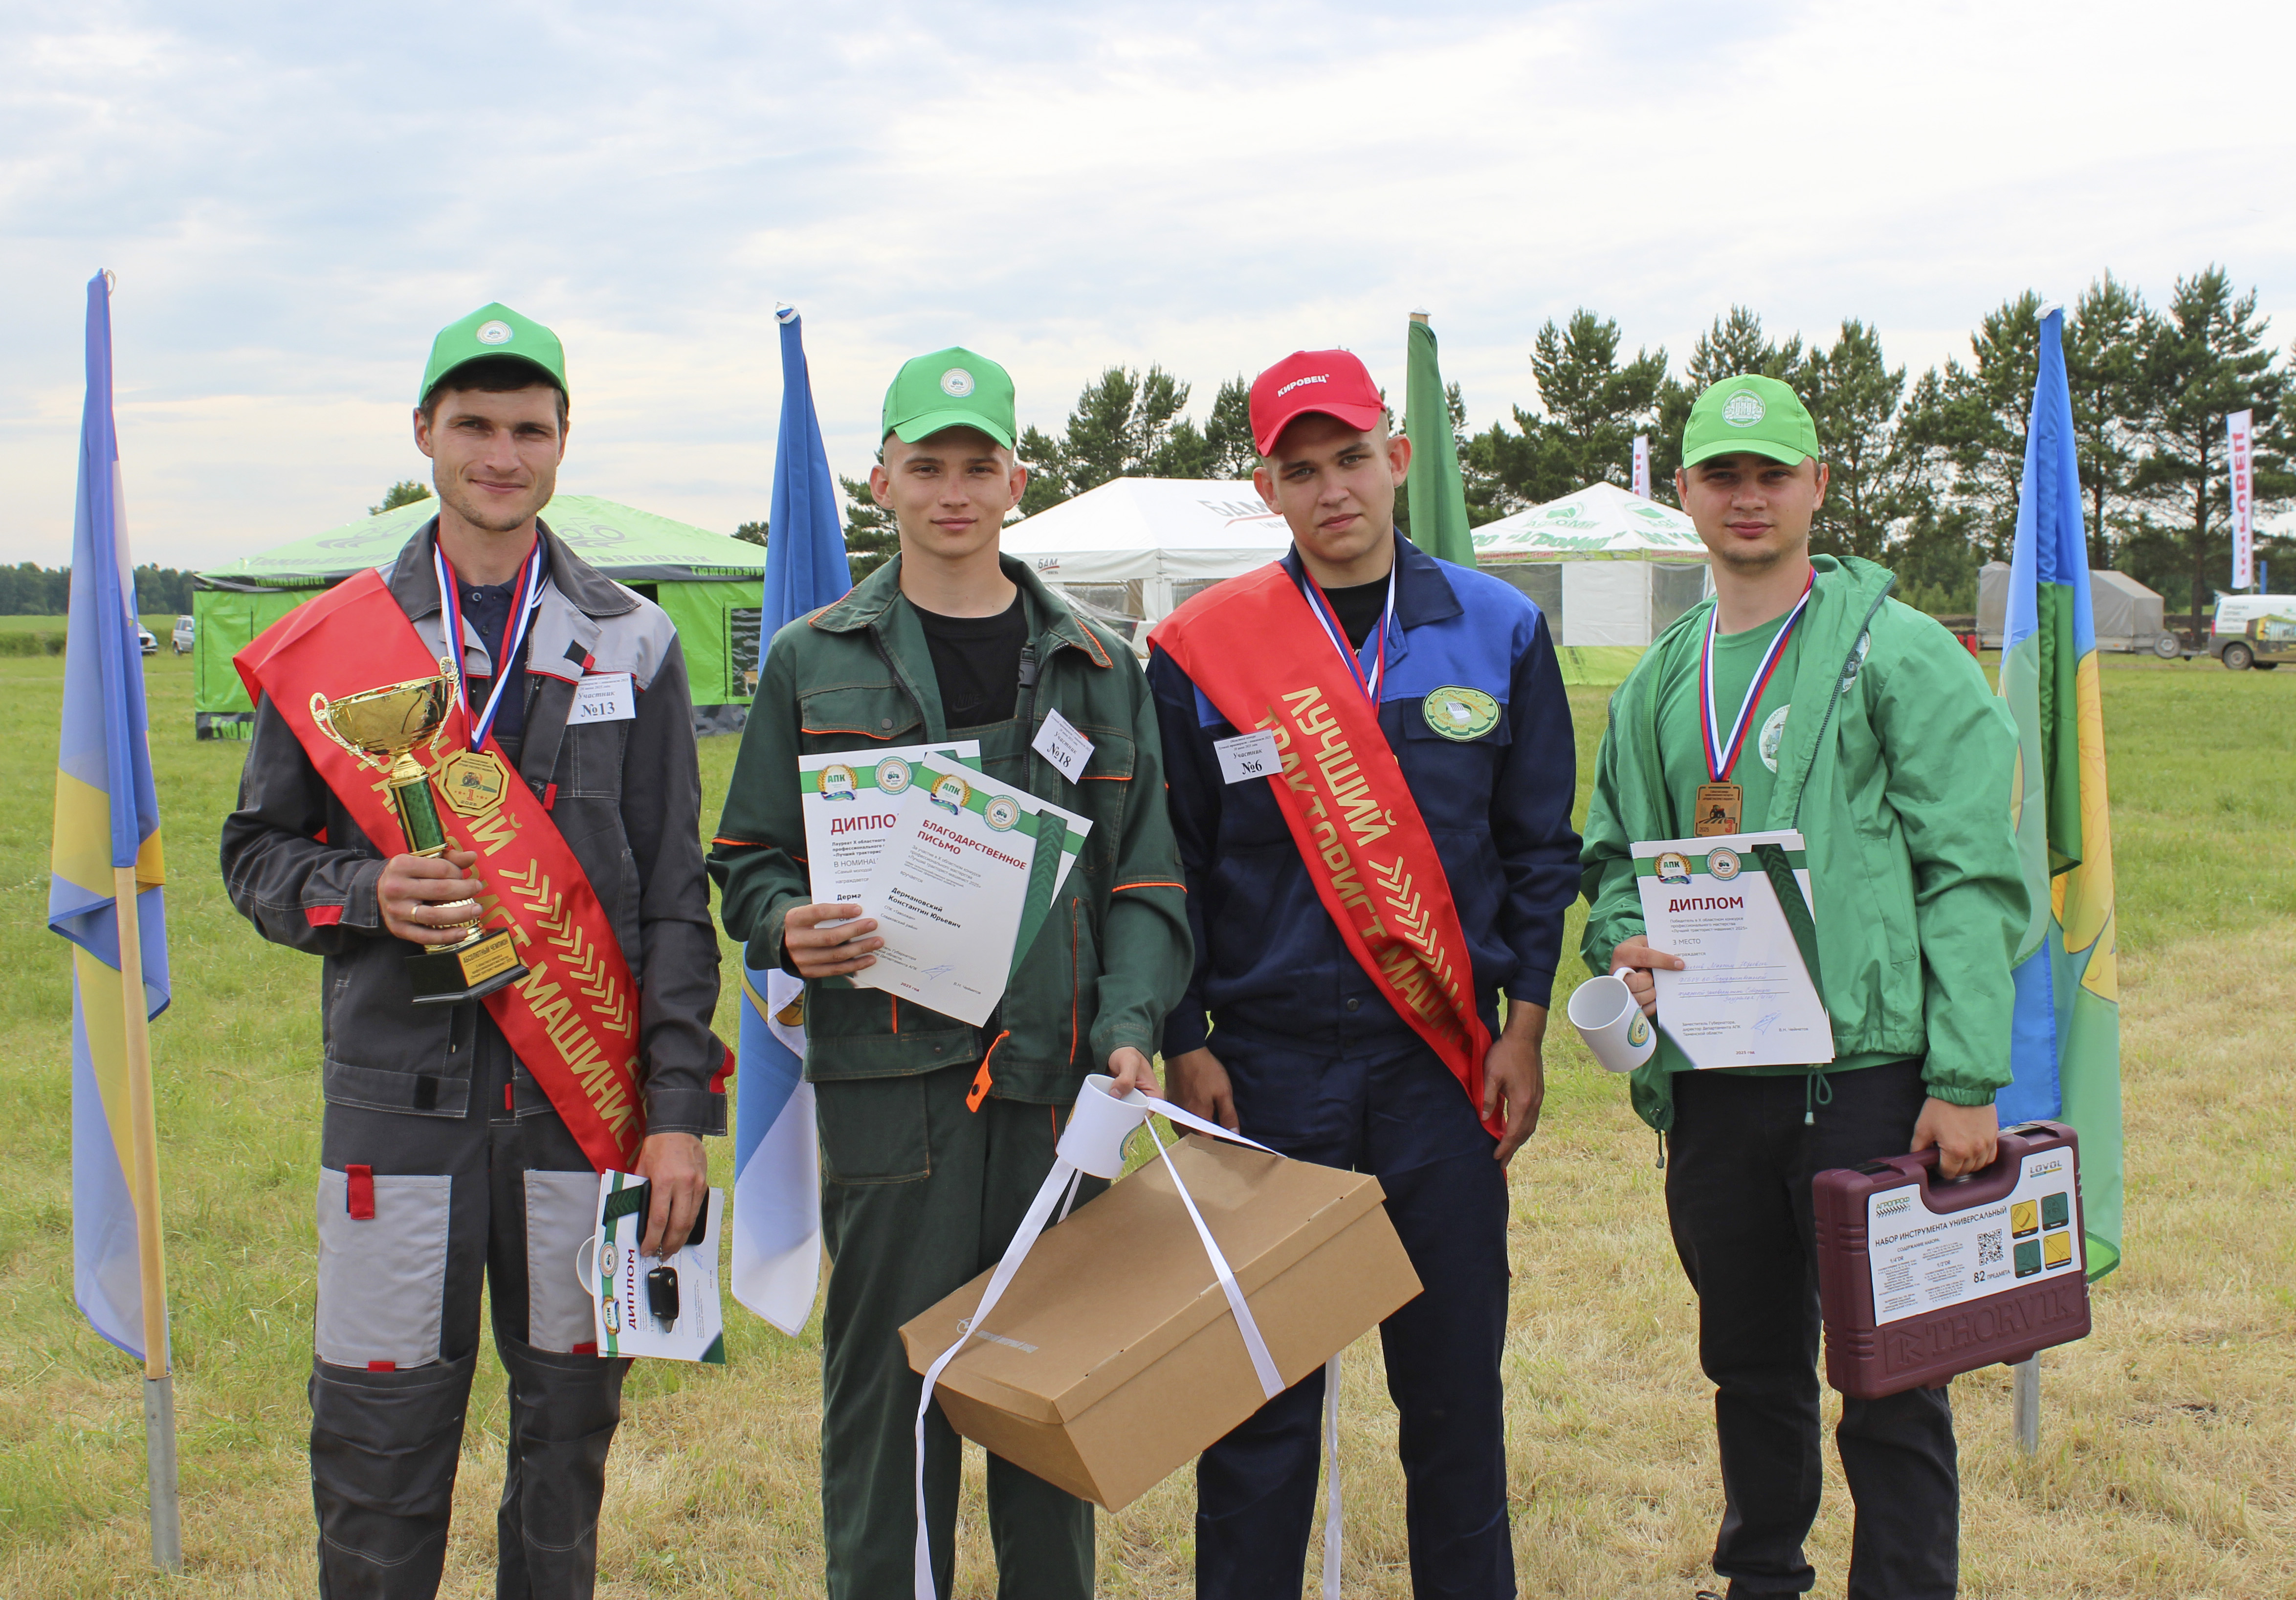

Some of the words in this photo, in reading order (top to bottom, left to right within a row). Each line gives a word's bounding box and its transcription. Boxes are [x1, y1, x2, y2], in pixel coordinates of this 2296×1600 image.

[1277, 375, 1327, 397] КИРОВЕЦ
[690, 566, 766, 576] Тюменьагр
[1038, 558, 1058, 569] БАМ
[581, 702, 615, 717] №13
[1054, 732, 1077, 755] Участник
[1047, 742, 1071, 767] №18
[1233, 749, 1263, 758] Участник
[1241, 759, 1262, 775] №6
[1281, 686, 1397, 847] ЛУЧШИЙ
[827, 773, 845, 783] АПК
[467, 789, 474, 800] 1
[942, 782, 960, 796] АПК
[831, 814, 898, 836] ДИПЛО
[1725, 819, 1733, 833] 3
[917, 831, 961, 855] ПИСЬМО
[923, 820, 1027, 870] БЛАГОДАРСТВЕННОЕ
[891, 887, 943, 912] Дермановский
[1669, 896, 1744, 912] ДИПЛОМ
[888, 895, 929, 916] Константин
[930, 912, 961, 929] Юрьевич
[2030, 1160, 2062, 1174] LOVOL
[1876, 1197, 1910, 1210] АГРОПРОФ
[1875, 1234, 1899, 1247] НАБОР
[1899, 1222, 1948, 1240] ИНСТРУМЕНТА
[1949, 1205, 2007, 1227] УНИВЕРСАЛЬНЫЙ
[1897, 1242, 1924, 1252] СОДЕРЖАНИЕ
[1974, 1270, 1986, 1283] 82
[1987, 1269, 2010, 1280] ПРЕДМЕТА
[627, 1249, 637, 1330] ДИПЛОМ
